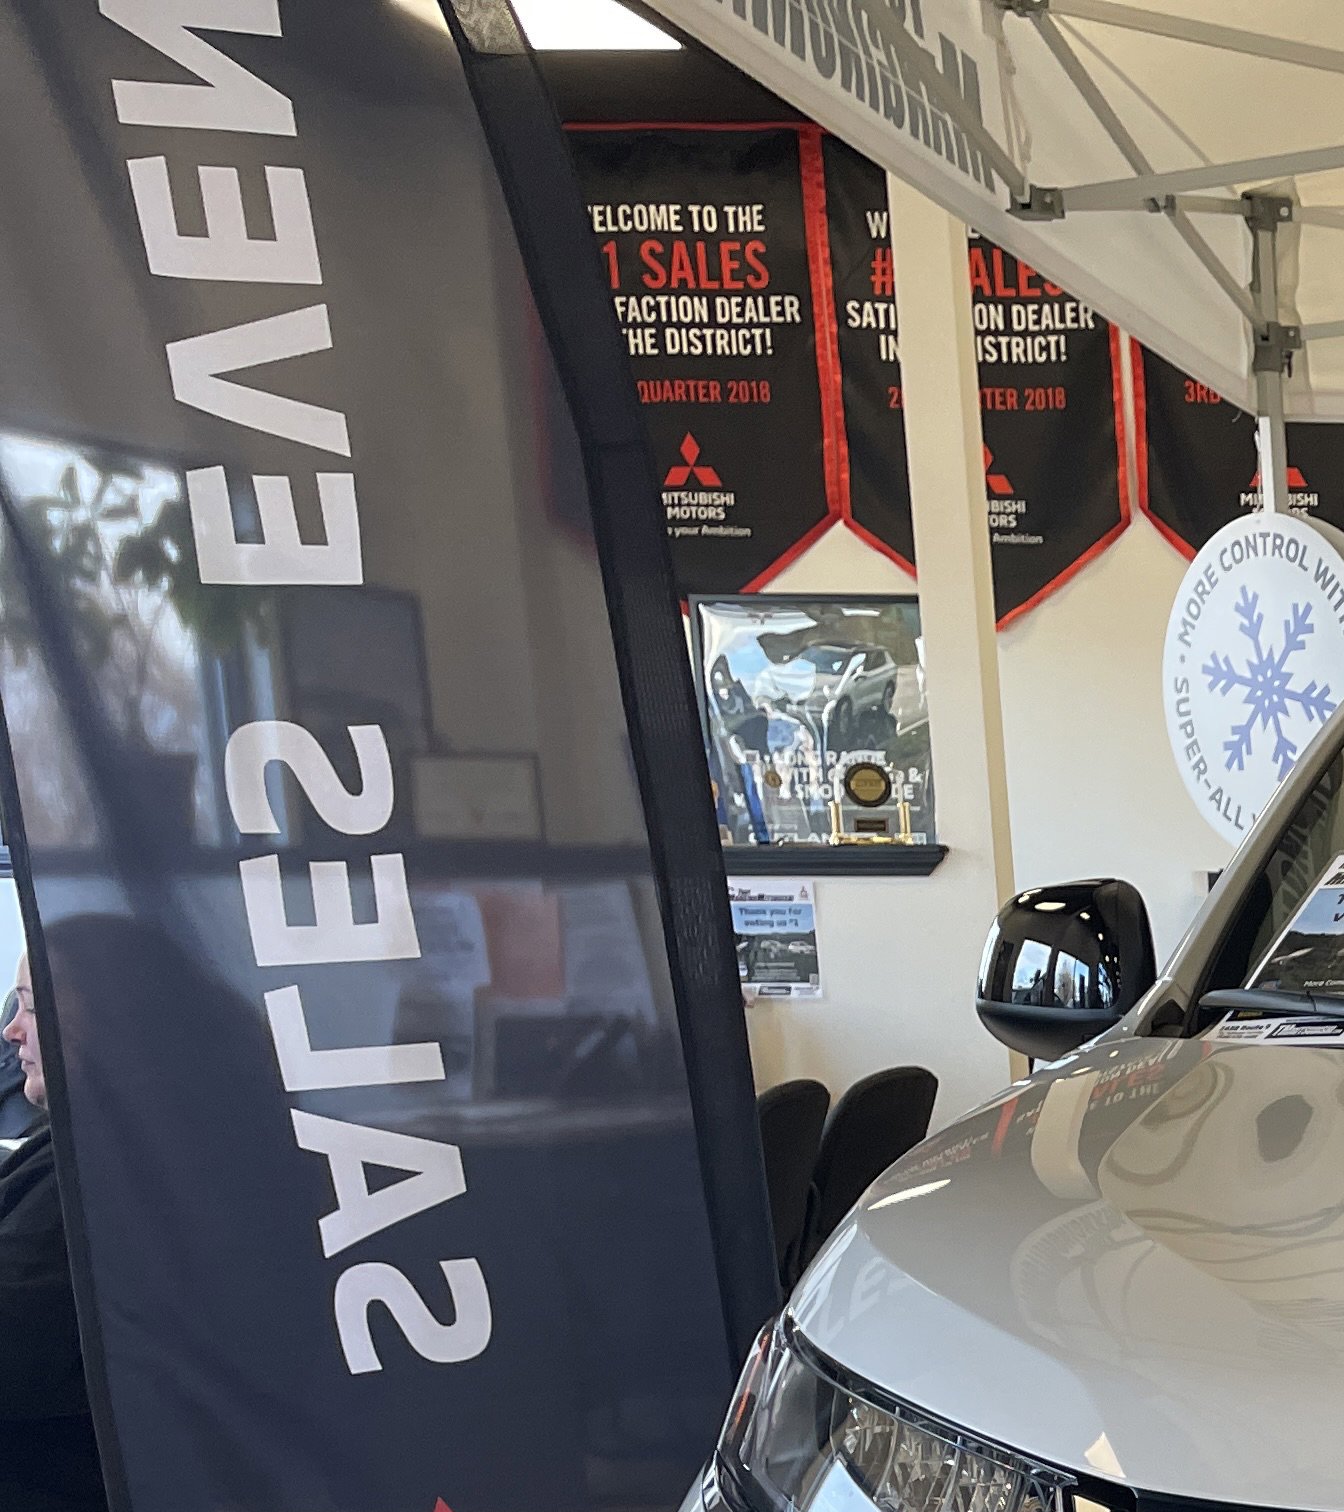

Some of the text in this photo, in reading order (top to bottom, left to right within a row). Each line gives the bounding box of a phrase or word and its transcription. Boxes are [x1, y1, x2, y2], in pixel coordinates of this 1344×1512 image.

[587, 204, 765, 233] ELCOME TO THE
[641, 240, 770, 291] SALES
[615, 296, 801, 324] FACTION DEALER
[1012, 302, 1095, 331] DEALER
[622, 328, 773, 356] HE DISTRICT!
[977, 335, 1067, 363] ISTRICT!
[728, 381, 770, 404] 2018
[1025, 387, 1066, 410] 2018
[667, 506, 725, 520] MOTORS
[1177, 563, 1219, 648] MORE
[1219, 532, 1309, 572] CONTROL
